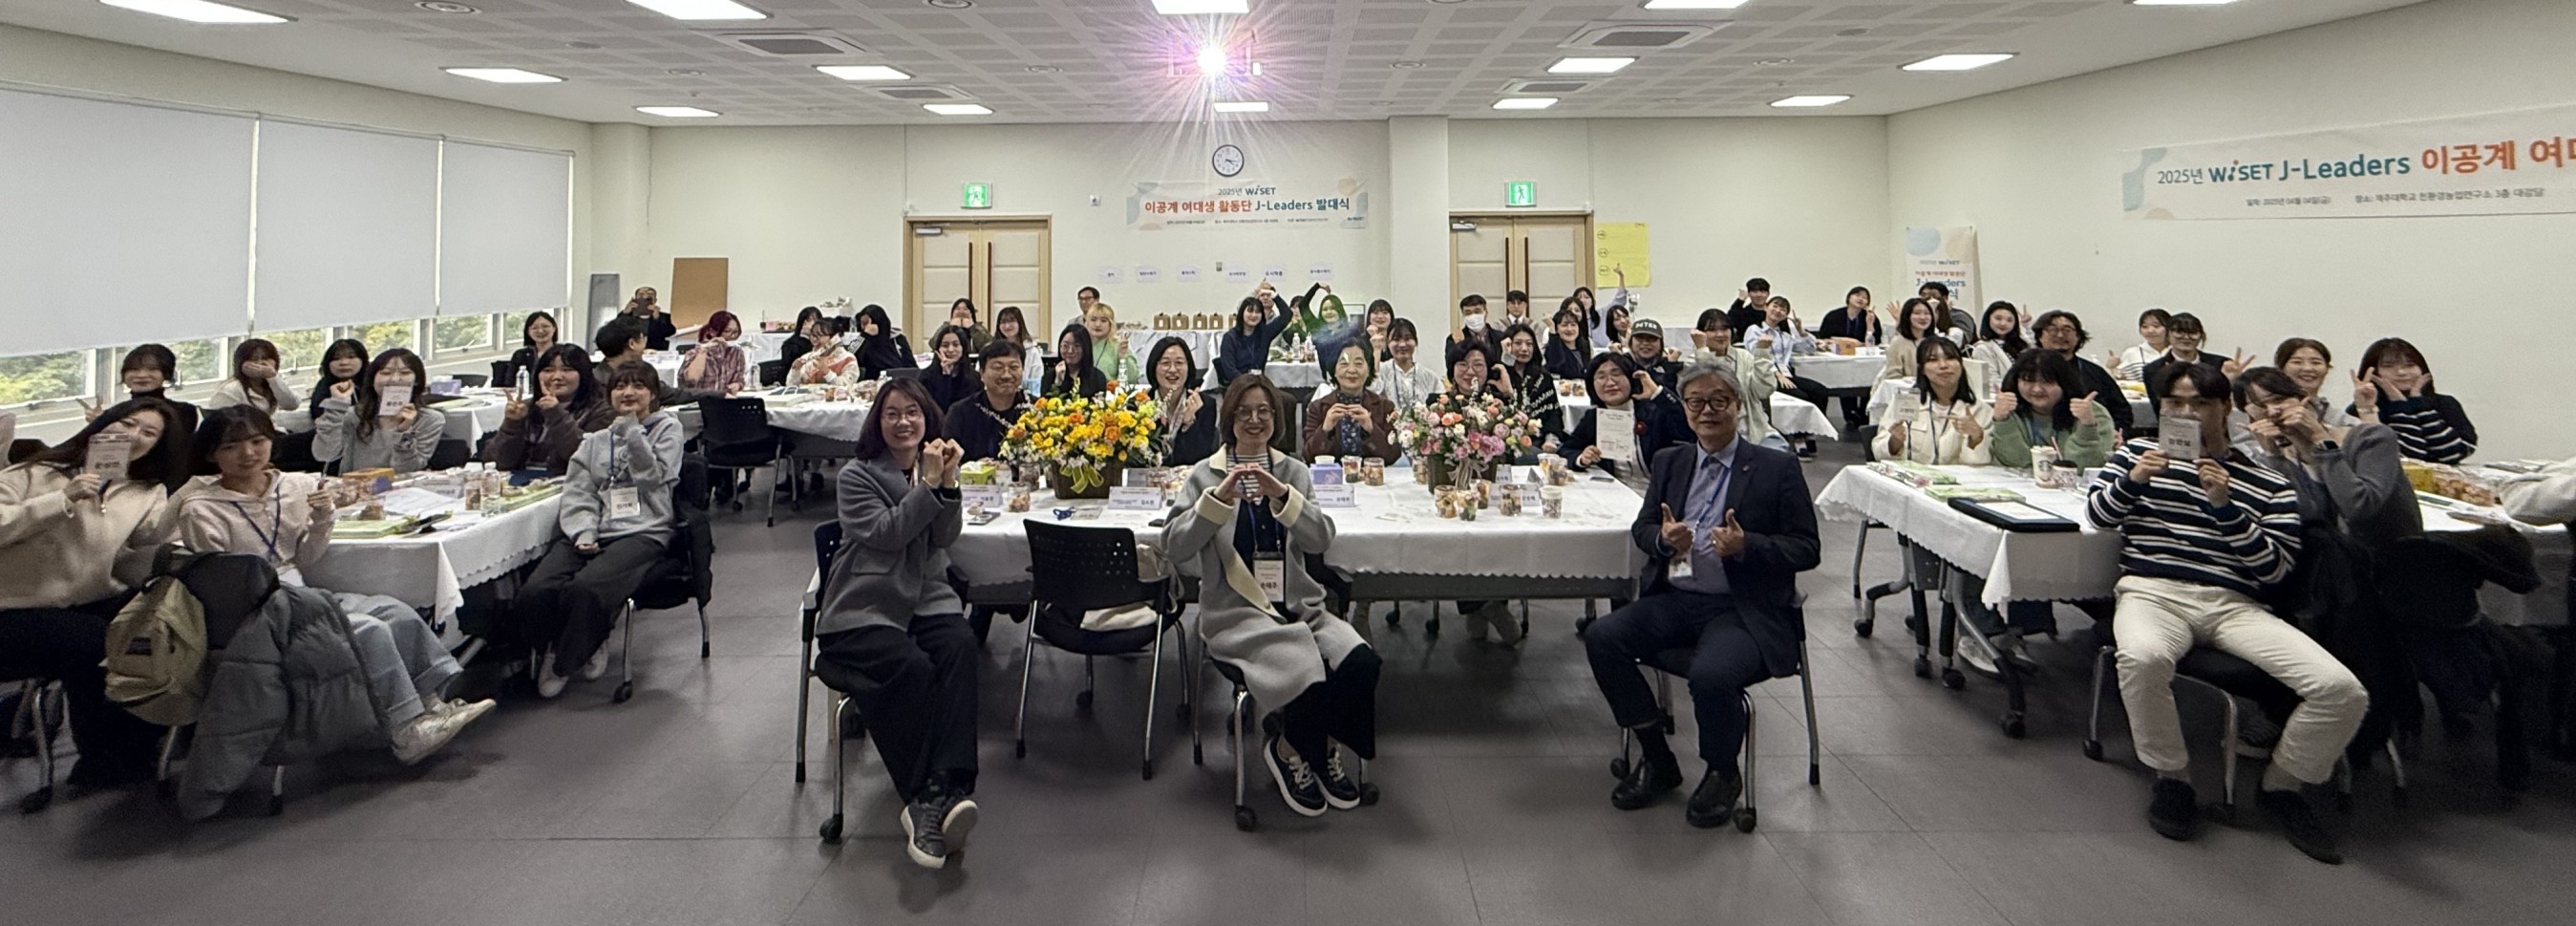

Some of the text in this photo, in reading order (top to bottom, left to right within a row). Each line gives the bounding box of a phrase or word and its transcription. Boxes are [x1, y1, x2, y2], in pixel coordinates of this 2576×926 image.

[2158, 168, 2203, 184] 2025년
[2278, 153, 2411, 182] J-Leaders
[2421, 140, 2516, 175] 이공계
[1218, 187, 1242, 196] 2025년
[1145, 198, 1350, 214] 이공계 여대생 활동단 J-Leaders 발대식
